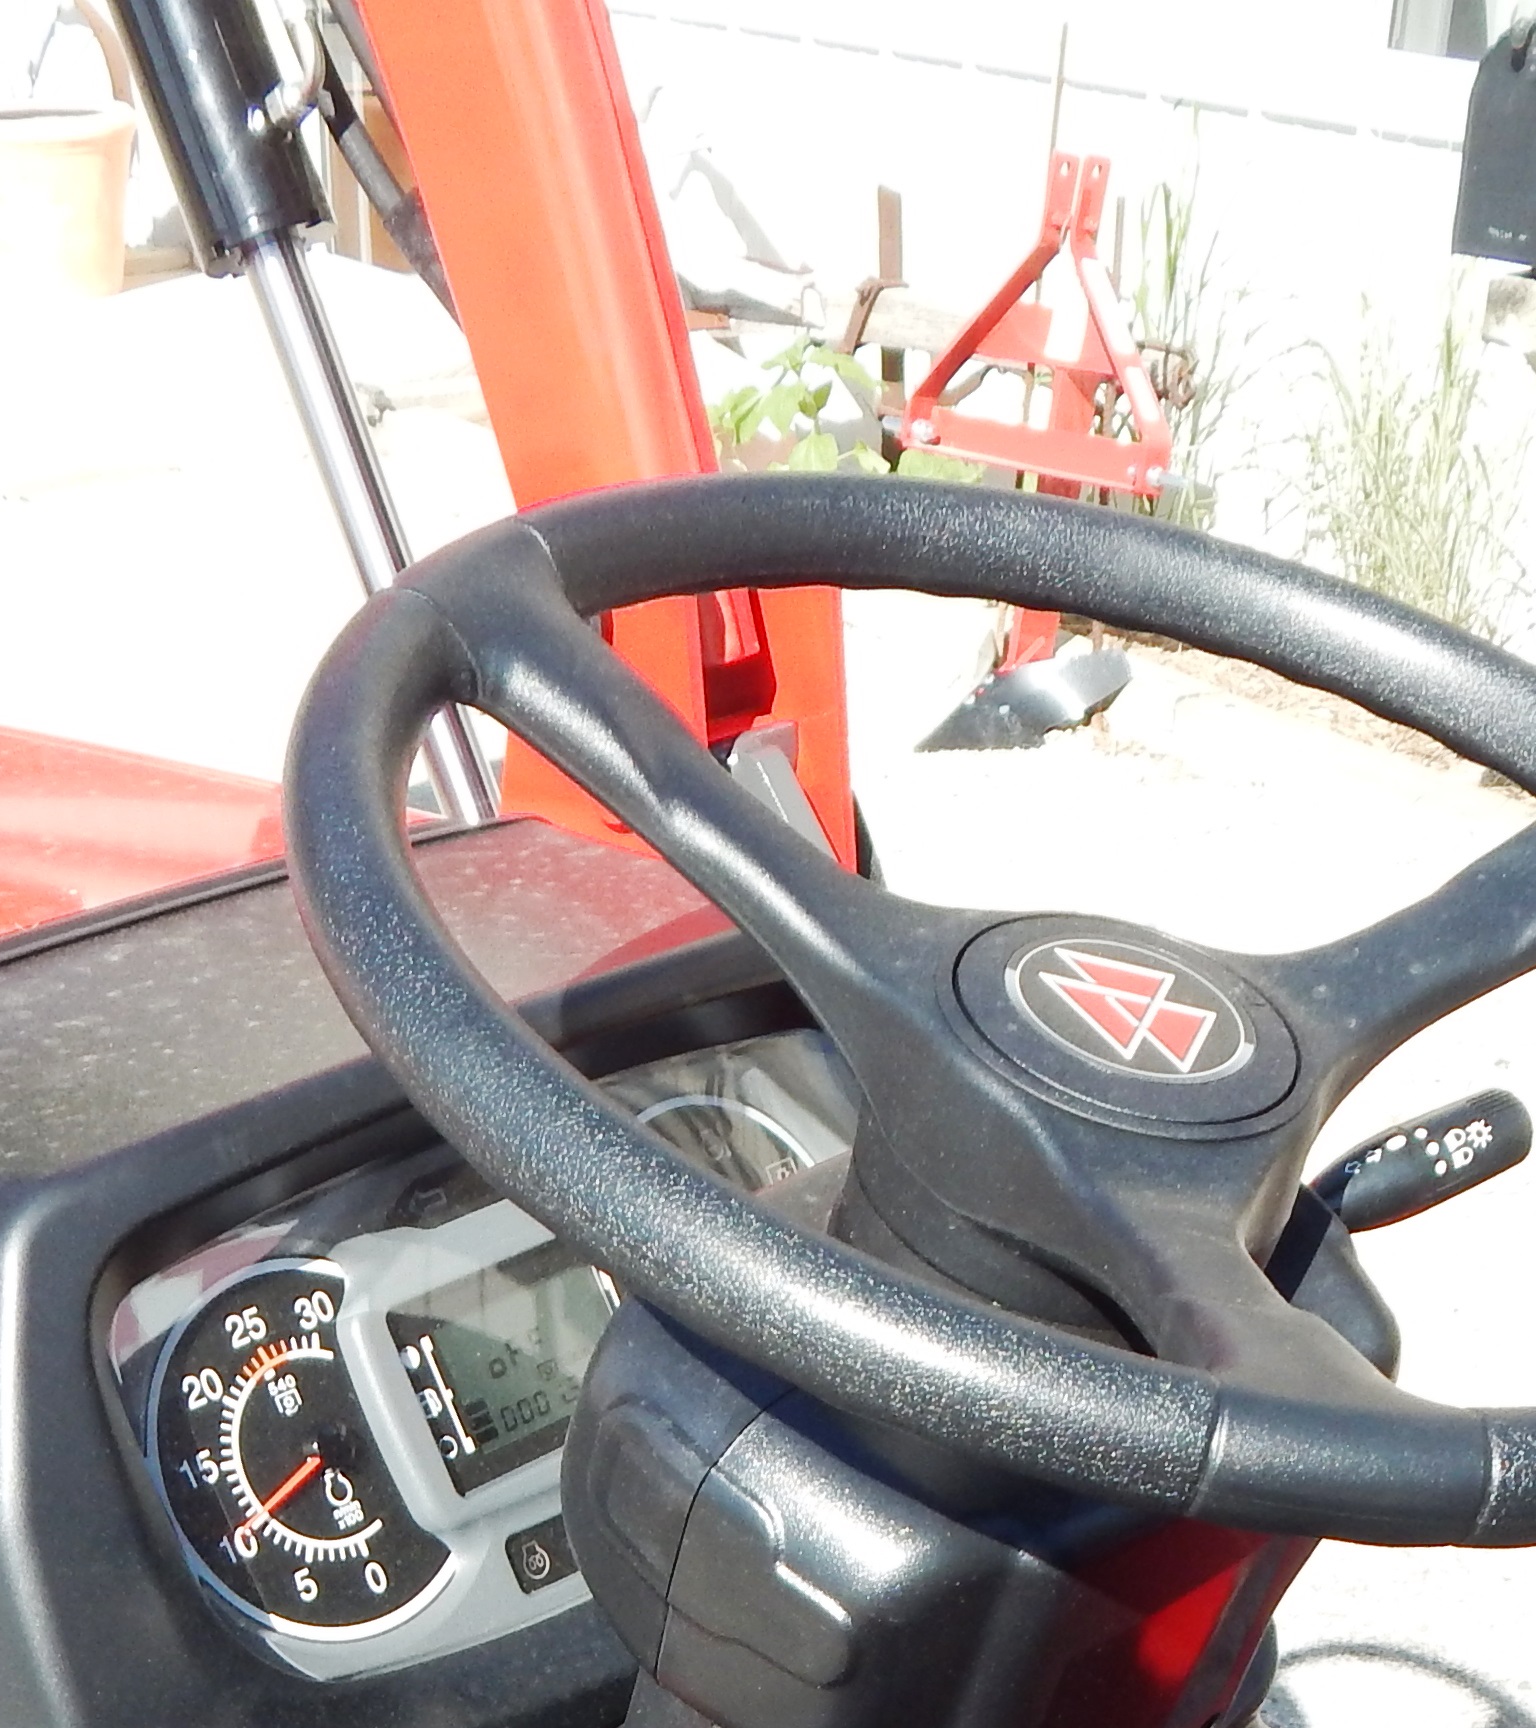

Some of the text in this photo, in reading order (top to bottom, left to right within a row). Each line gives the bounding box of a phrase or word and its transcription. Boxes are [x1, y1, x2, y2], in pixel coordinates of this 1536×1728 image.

[225, 1306, 267, 1349] 25
[294, 1291, 334, 1330] 30
[182, 1368, 224, 1411] 20
[268, 1373, 297, 1396] 540
[179, 1449, 219, 1489] 15
[219, 1526, 259, 1564] 10
[293, 1567, 318, 1602] 5
[364, 1561, 388, 1594] 0
